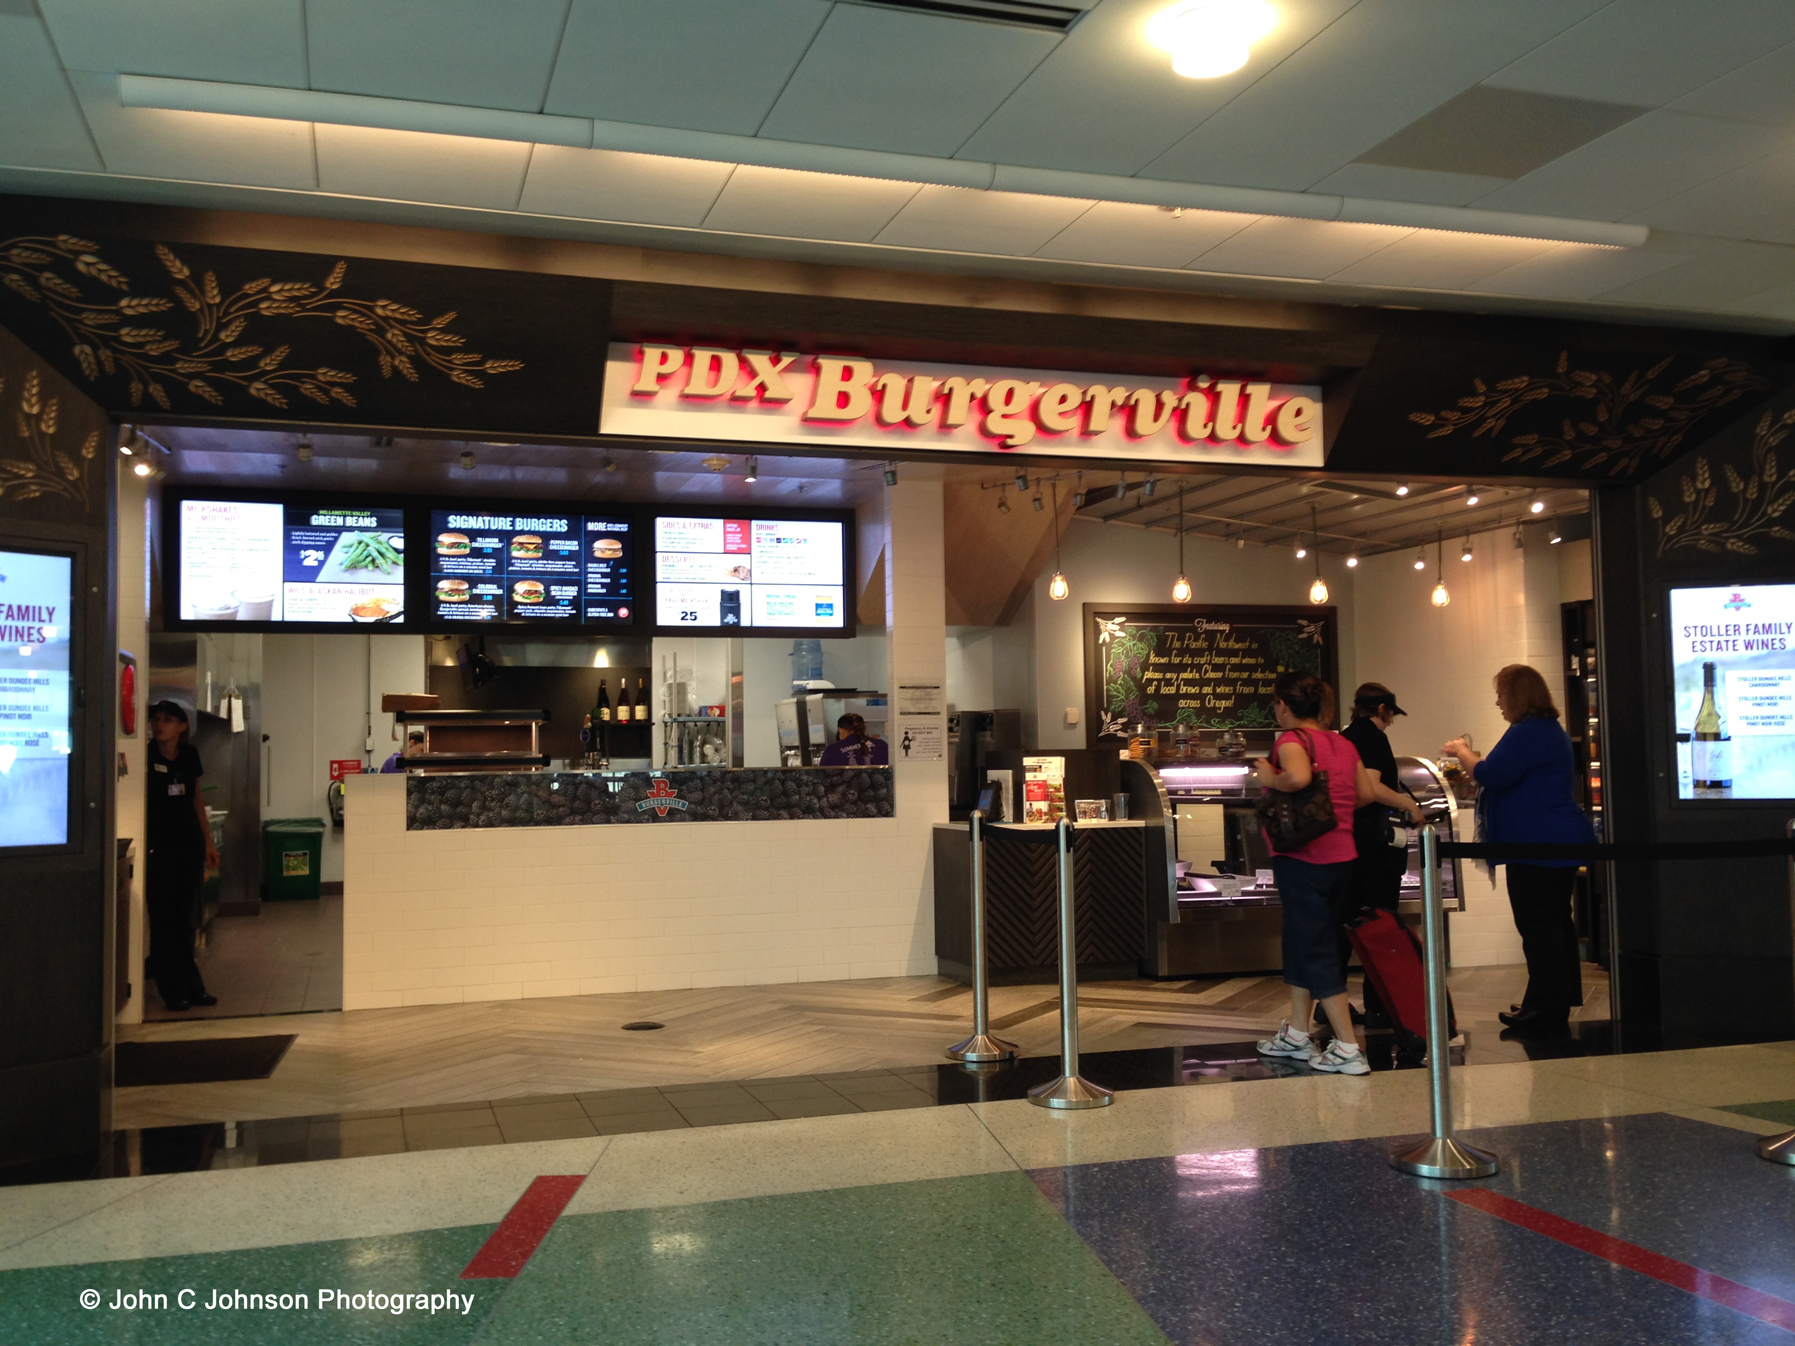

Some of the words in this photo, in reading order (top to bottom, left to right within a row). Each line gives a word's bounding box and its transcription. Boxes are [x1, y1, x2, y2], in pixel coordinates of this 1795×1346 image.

[631, 343, 800, 403] PDX
[801, 354, 1317, 449] Burgerville
[310, 514, 344, 526] GREEN
[344, 516, 378, 527] BEANS
[447, 515, 513, 530] SIGNATURE
[514, 517, 568, 533] BURGERS
[587, 521, 607, 531] MORE
[680, 610, 698, 621] 25
[1194, 618, 1230, 633] Featuring
[1683, 624, 1741, 638] STOLLER
[1745, 622, 1793, 636] FAMILY
[1165, 632, 1182, 649] The
[1183, 632, 1209, 649] Pacific
[1214, 632, 1251, 649] Northwest
[1251, 641, 1259, 649] is
[1691, 639, 1740, 653] ESTATE
[1743, 638, 1787, 651] WINES
[1171, 650, 1182, 664] for
[1183, 653, 1193, 664] its
[1193, 651, 1211, 664] craft
[1211, 650, 1229, 664] beers
[1229, 651, 1242, 664] and
[1257, 656, 1265, 664] to
[1142, 666, 1164, 684] please
[1165, 672, 1178, 683] any
[1201, 664, 1224, 679] Choose
[1225, 665, 1240, 679] from
[1240, 671, 1250, 679] our
[1251, 667, 1278, 679] selection
[1146, 681, 1158, 694] of
[1160, 681, 1177, 694] local
[1179, 681, 1200, 694] brews
[1201, 681, 1214, 694] and
[1215, 684, 1234, 694] wines
[1236, 681, 1255, 694] from
[1178, 699, 1201, 708] across
[1205, 695, 1235, 713] Oregon!
